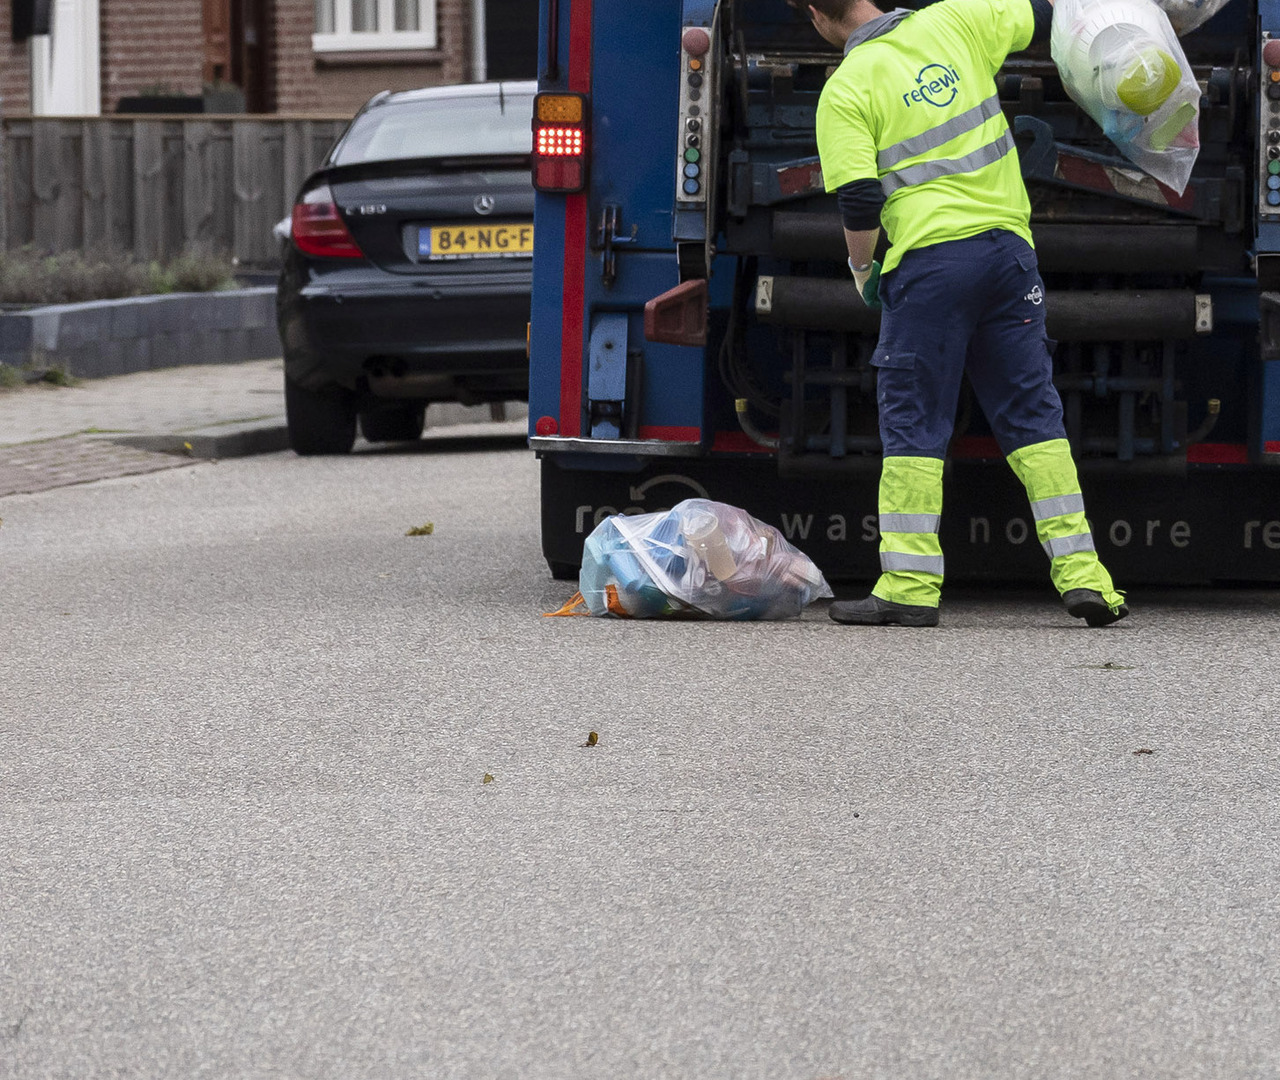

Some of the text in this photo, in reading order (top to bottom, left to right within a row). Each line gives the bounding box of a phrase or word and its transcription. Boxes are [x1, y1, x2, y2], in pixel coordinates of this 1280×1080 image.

[903, 67, 960, 107] renewi
[438, 228, 531, 251] 84-NG-F
[781, 512, 1192, 548] was no ore
